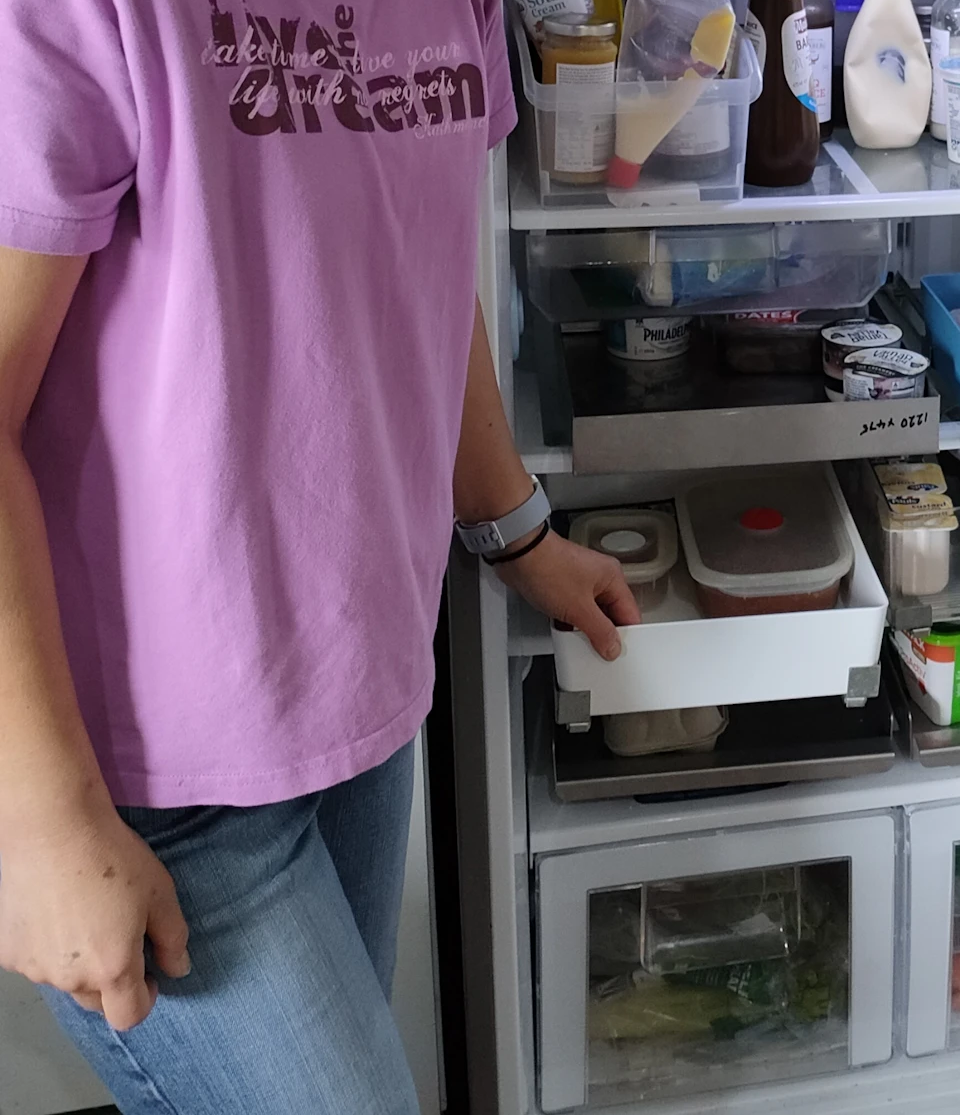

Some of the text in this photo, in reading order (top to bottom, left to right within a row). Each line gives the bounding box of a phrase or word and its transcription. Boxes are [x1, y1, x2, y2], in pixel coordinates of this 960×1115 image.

[531, 1, 566, 18] Cream
[380, 70, 457, 115] regrets
[735, 311, 793, 320] DATES
[643, 322, 688, 342] PHILADEL
[900, 412, 928, 428] 1220
